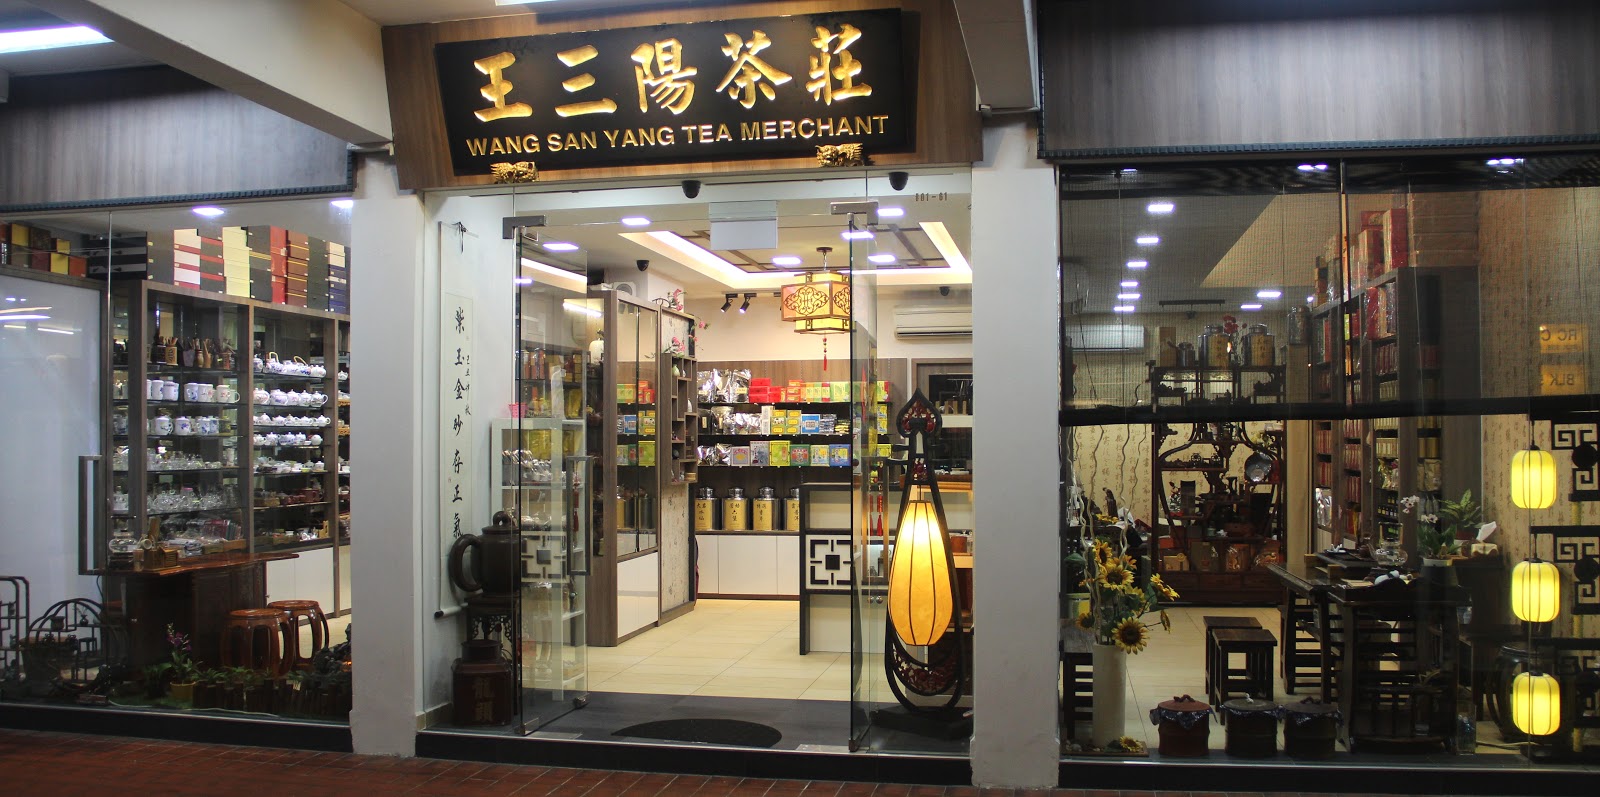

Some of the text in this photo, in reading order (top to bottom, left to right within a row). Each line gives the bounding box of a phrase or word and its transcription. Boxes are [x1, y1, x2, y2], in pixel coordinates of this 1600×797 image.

[472, 23, 874, 123] 王三陽茶莊
[466, 115, 890, 157] WANG SAN YANG TEA MERCHANT
